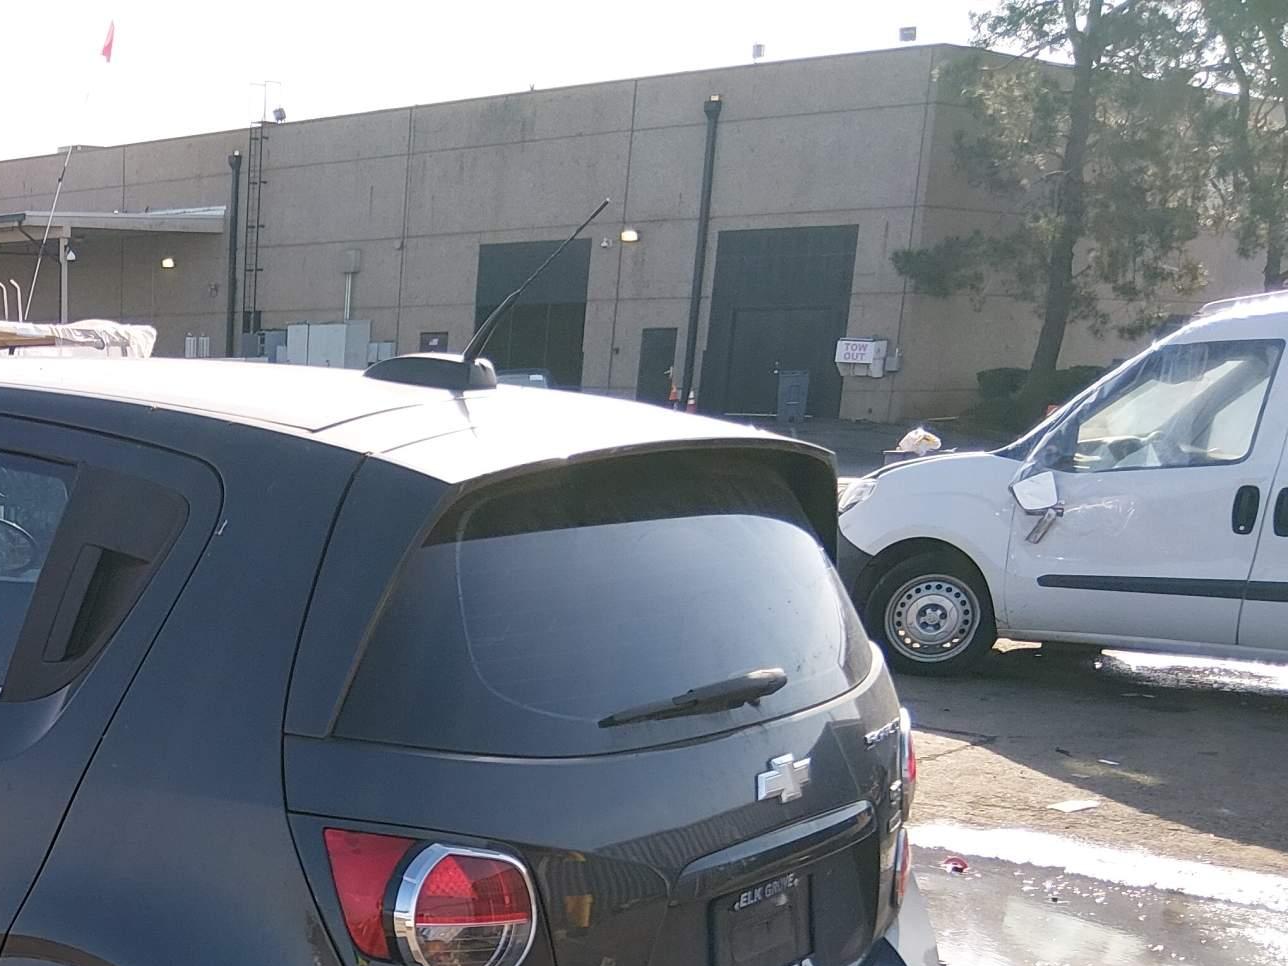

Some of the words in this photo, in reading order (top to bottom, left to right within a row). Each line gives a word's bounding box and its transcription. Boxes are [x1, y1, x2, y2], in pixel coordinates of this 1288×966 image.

[844, 342, 869, 352] TOW
[843, 352, 866, 361] OUT
[739, 886, 763, 908] ELK
